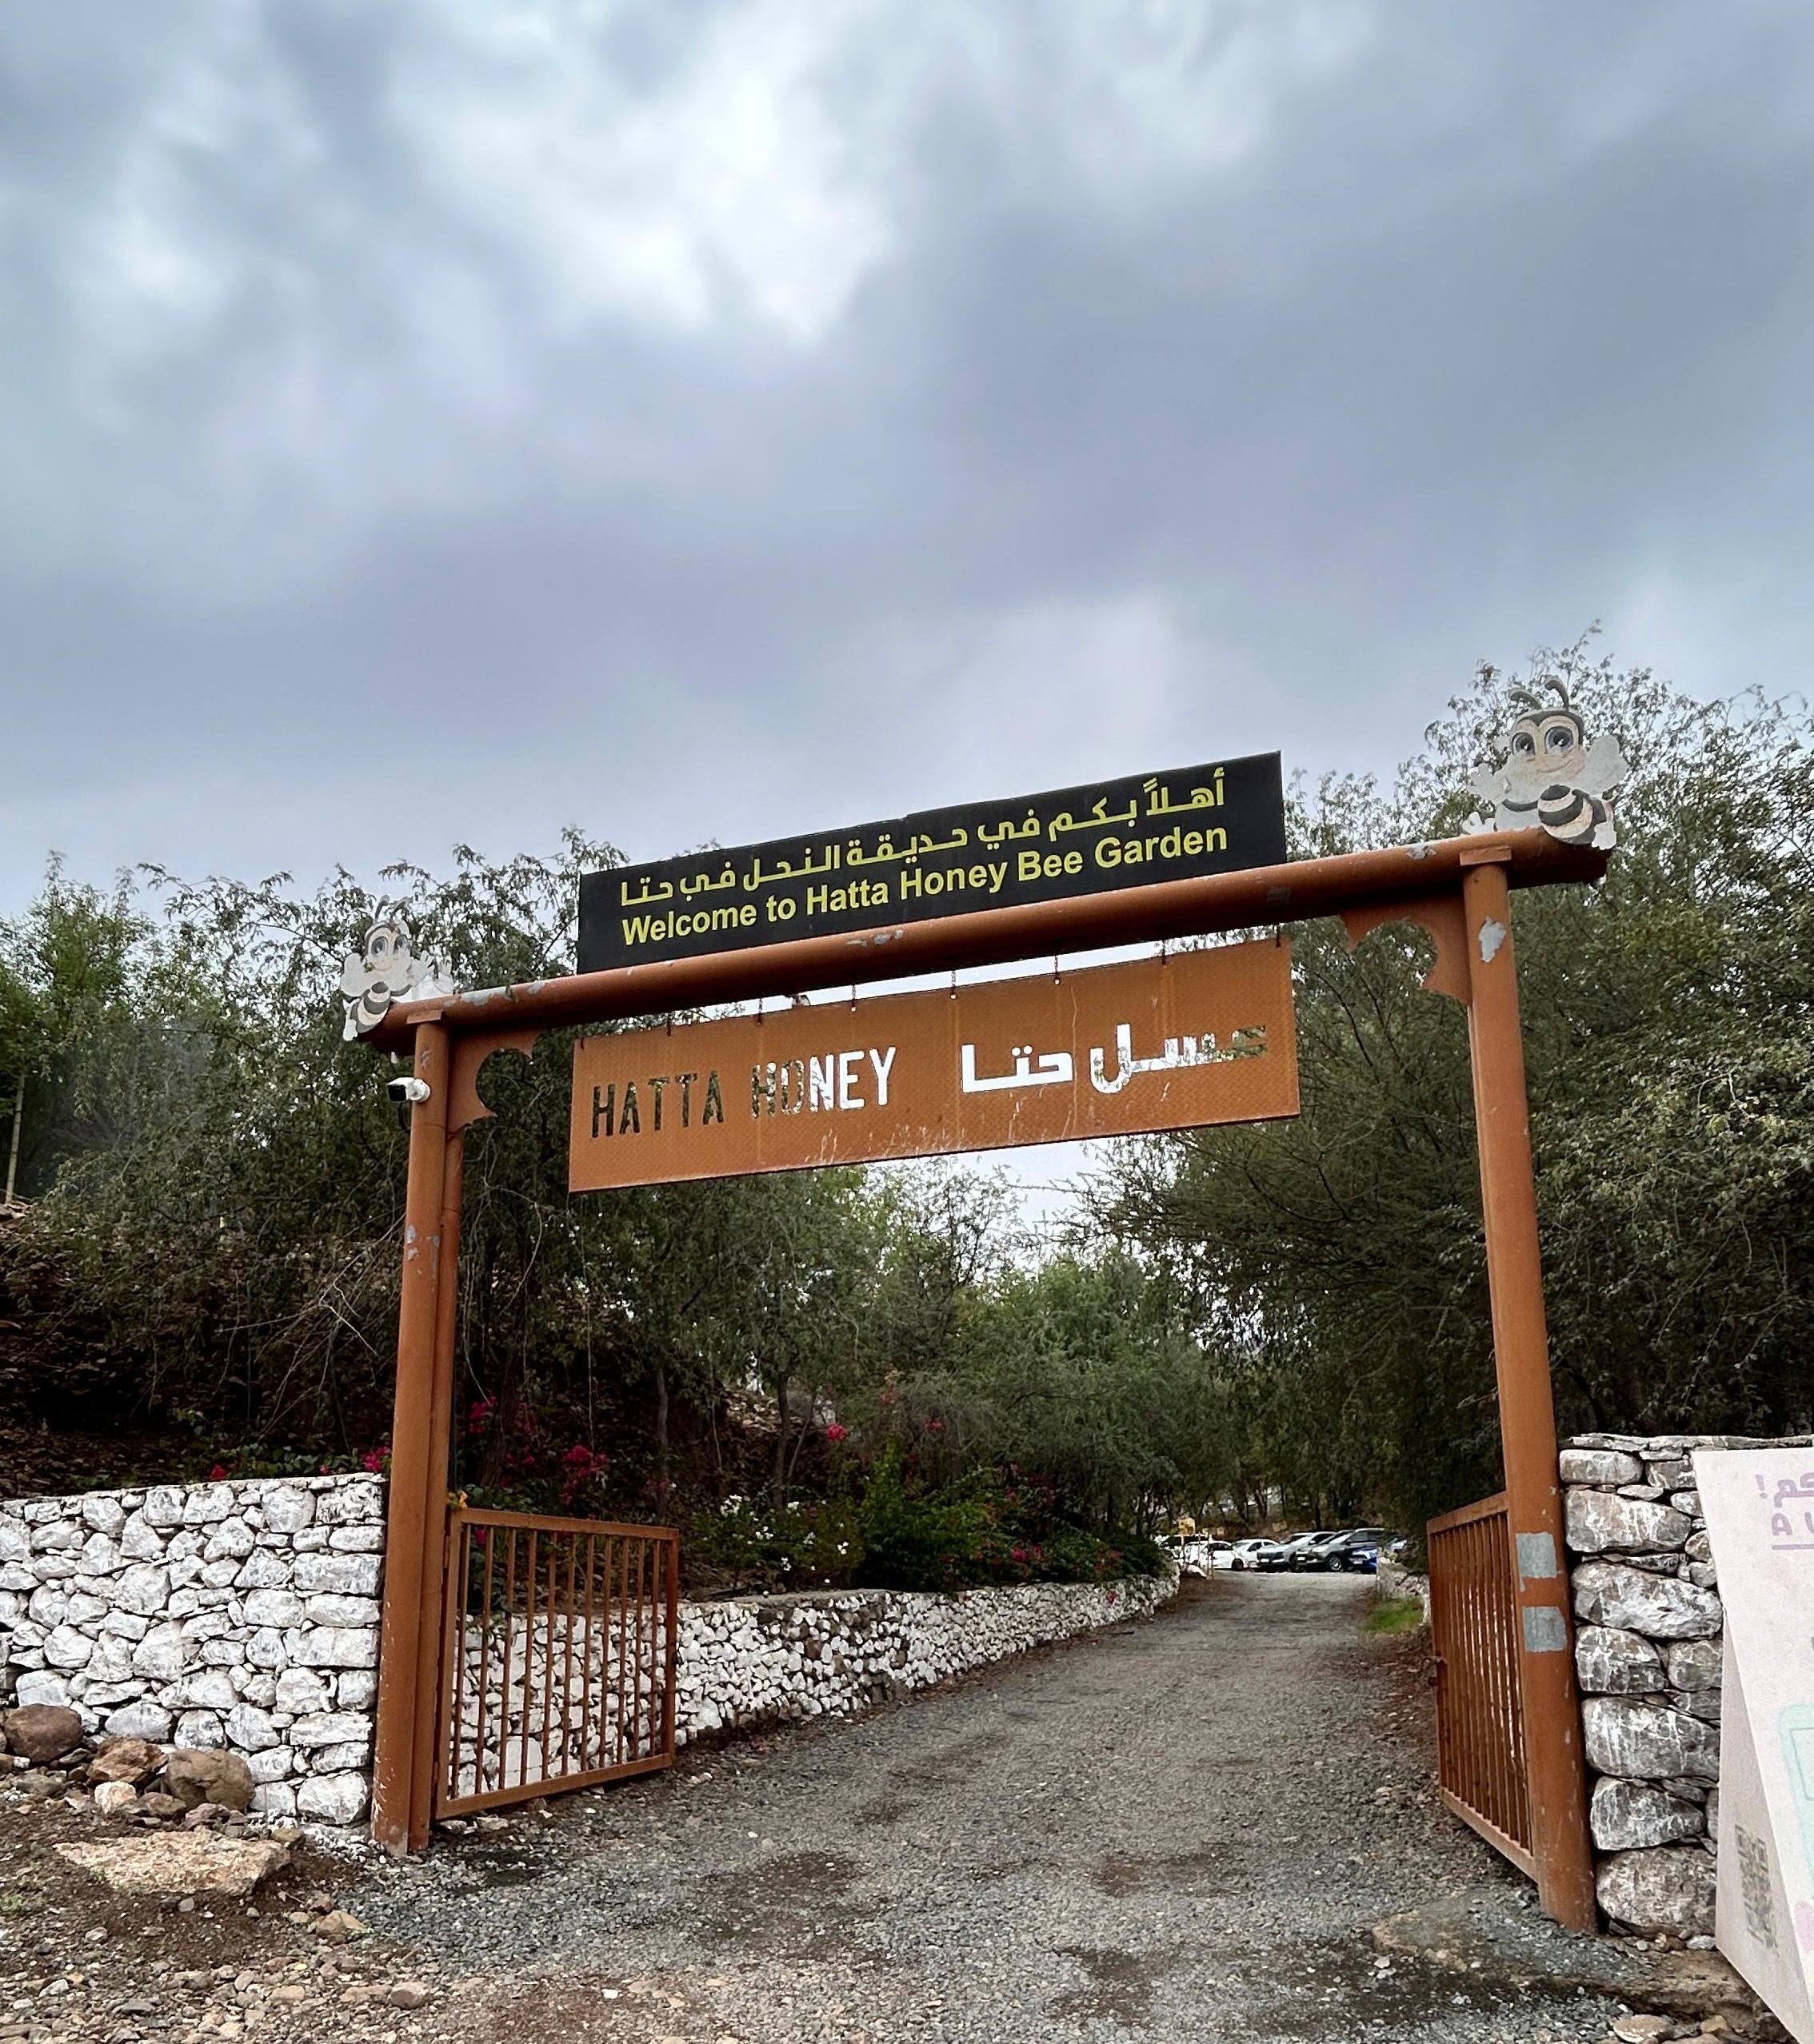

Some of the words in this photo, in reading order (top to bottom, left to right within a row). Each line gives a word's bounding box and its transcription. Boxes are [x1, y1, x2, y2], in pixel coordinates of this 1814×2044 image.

[977, 808, 1040, 850] في
[1048, 796, 1137, 842] بكم
[742, 844, 841, 892] النحل
[846, 827, 968, 866] حديقة
[621, 903, 757, 946] Welcome
[765, 894, 797, 923] to
[806, 878, 889, 916] Hatta
[900, 861, 1009, 900] Honey
[1017, 849, 1084, 881] Bee
[1094, 825, 1229, 868] Garden
[621, 876, 673, 907] حتا
[679, 860, 736, 902] في
[961, 1043, 1073, 1093] حتا
[1089, 1023, 1267, 1094] عسل
[591, 1070, 725, 1139] HATTA
[750, 1045, 897, 1120] HONEY
